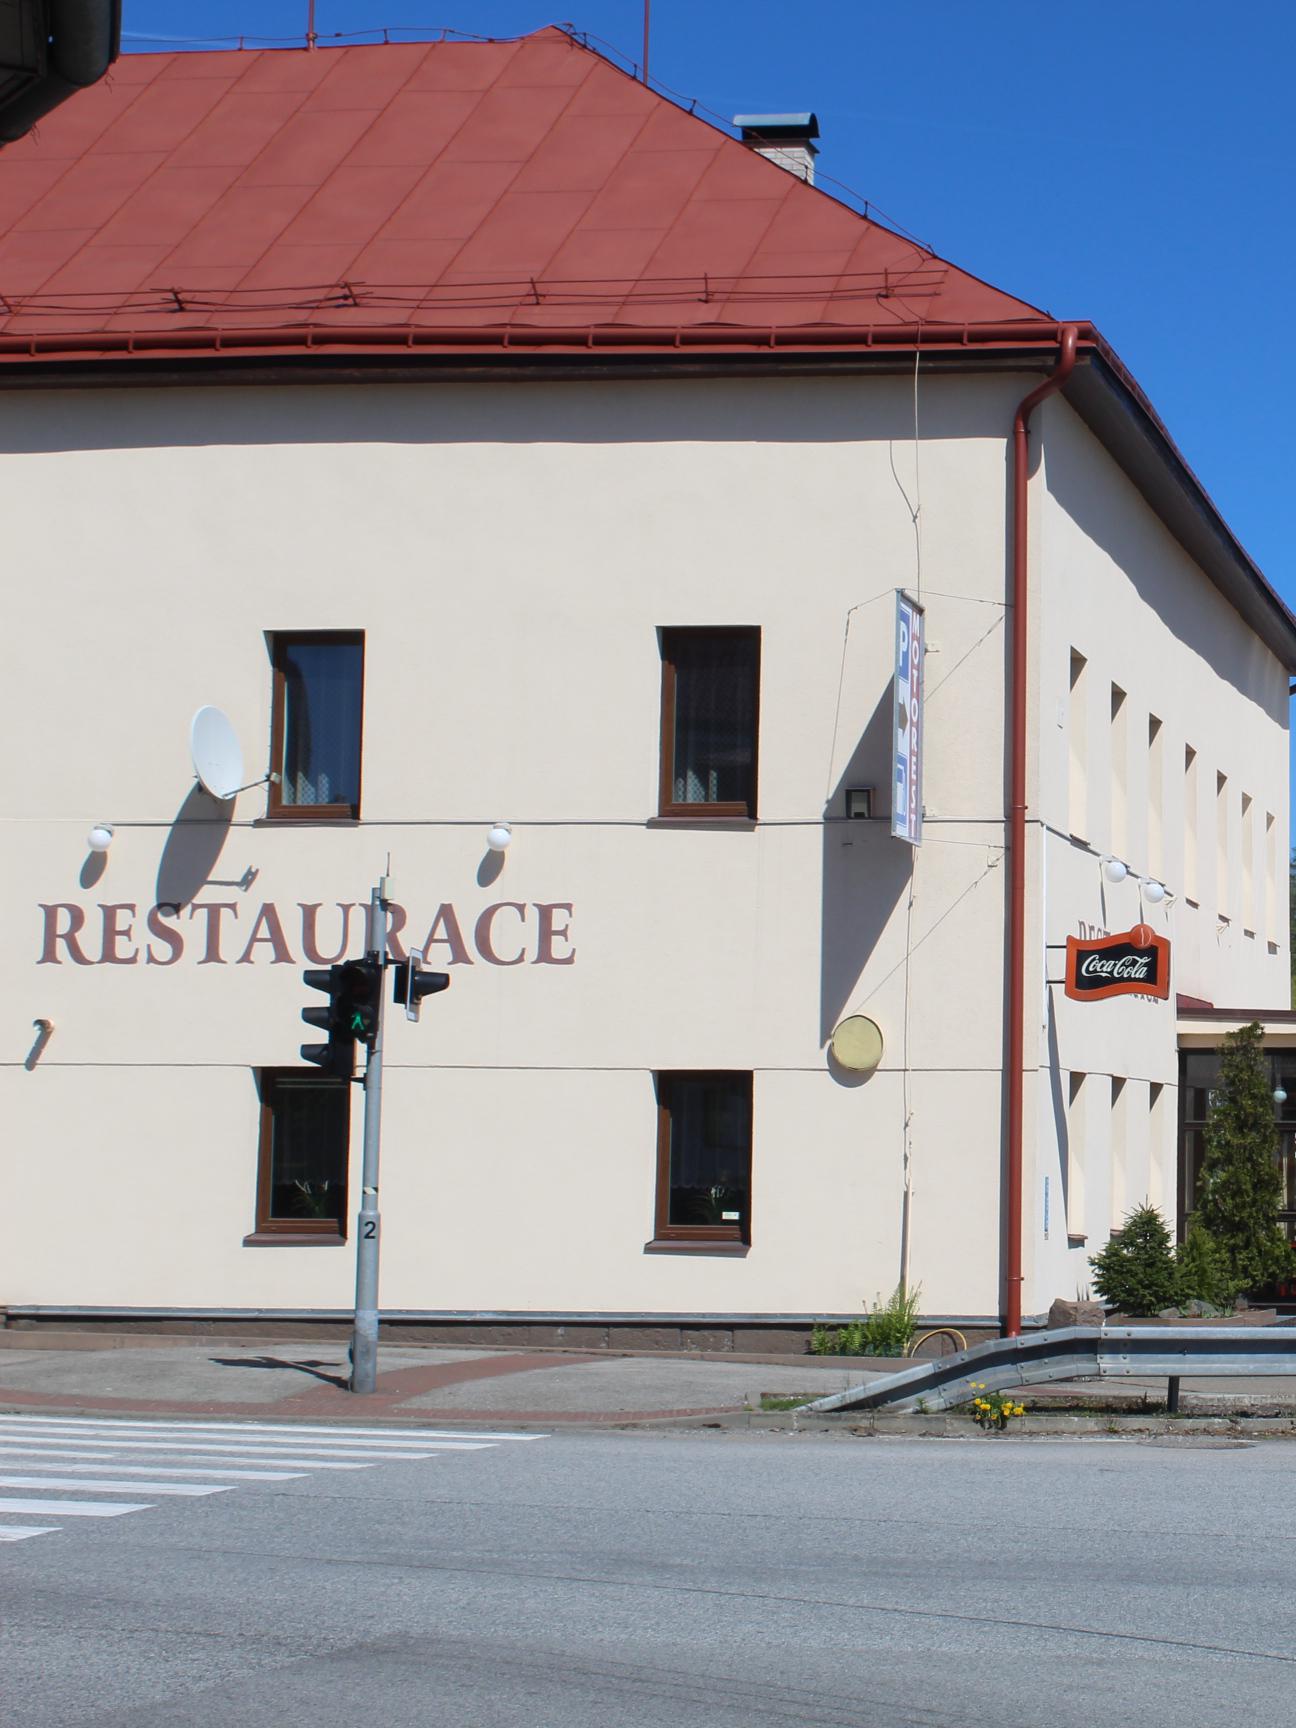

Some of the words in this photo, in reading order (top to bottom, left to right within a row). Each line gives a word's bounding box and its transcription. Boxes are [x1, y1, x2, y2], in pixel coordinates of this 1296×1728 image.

[899, 621, 908, 667] P
[911, 611, 920, 837] MOTOREST
[37, 901, 577, 966] RESTAURACE
[1081, 954, 1152, 979] Coca-Cola
[363, 1220, 377, 1240] 2
